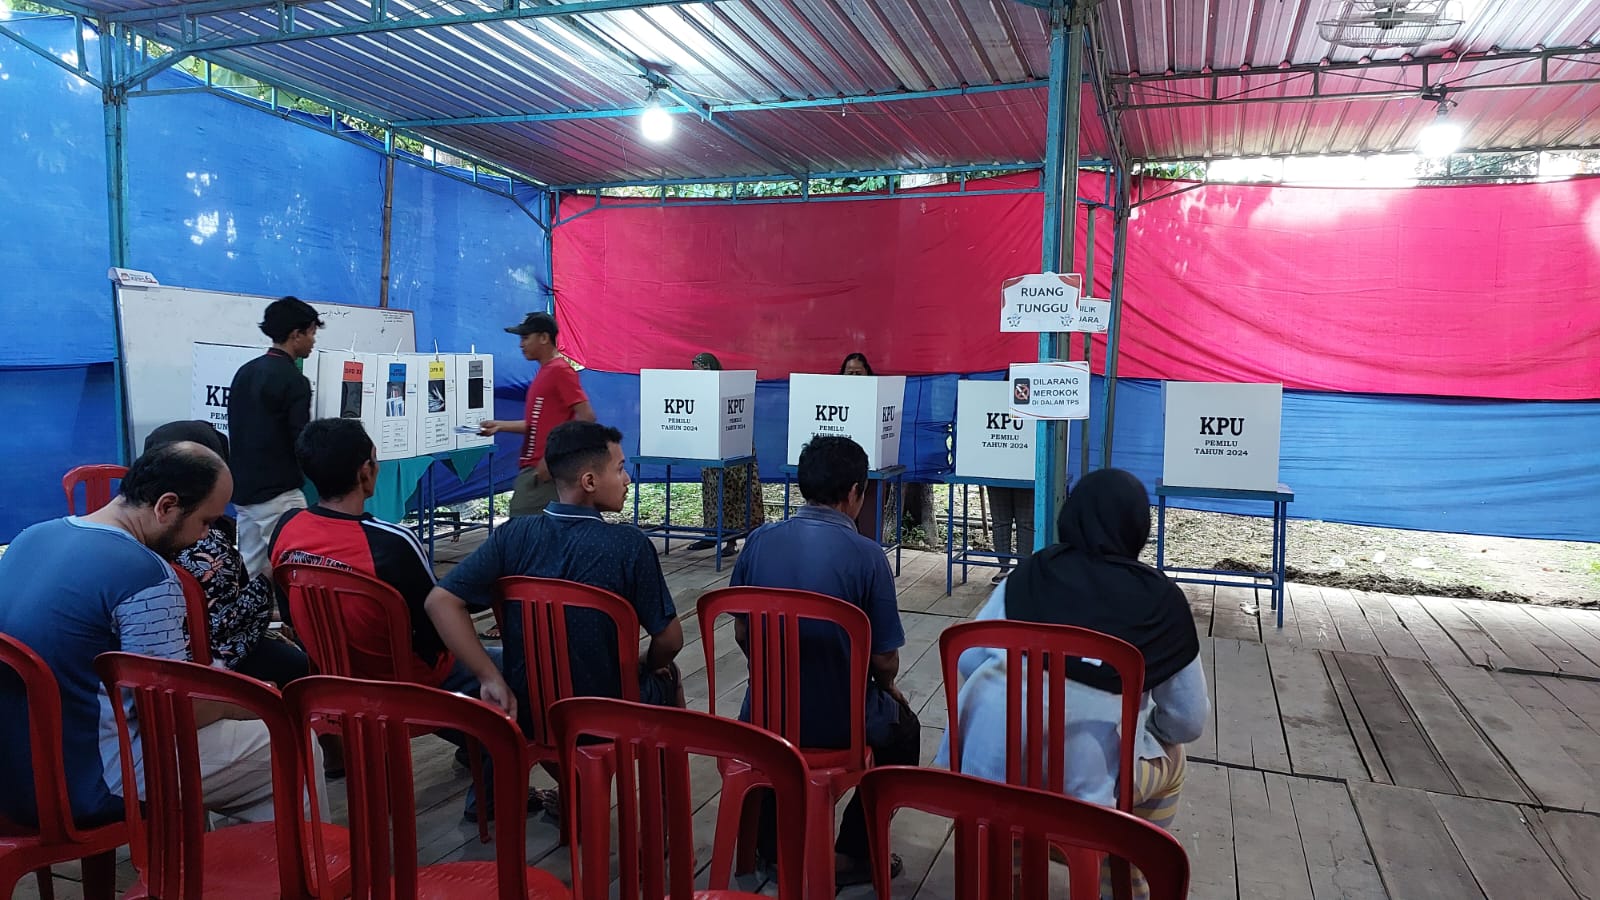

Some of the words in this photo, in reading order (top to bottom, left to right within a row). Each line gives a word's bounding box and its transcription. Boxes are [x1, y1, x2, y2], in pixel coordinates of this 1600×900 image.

[1021, 287, 1064, 297] RUANG
[1016, 303, 1069, 313] TUNGGU
[1079, 305, 1097, 313] ILIK
[1033, 377, 1079, 386] DILARANG
[205, 384, 231, 408] KP
[1033, 389, 1079, 397] MEROKOK
[664, 398, 695, 415] KPU
[727, 398, 746, 415] KPU
[210, 412, 229, 420] PEM
[815, 404, 850, 422] KPU
[882, 405, 896, 423] KPU
[986, 412, 1024, 431] KPU
[1199, 416, 1245, 436] KPU
[991, 433, 1020, 441] PEMILU
[982, 441, 1008, 449] TAHUN
